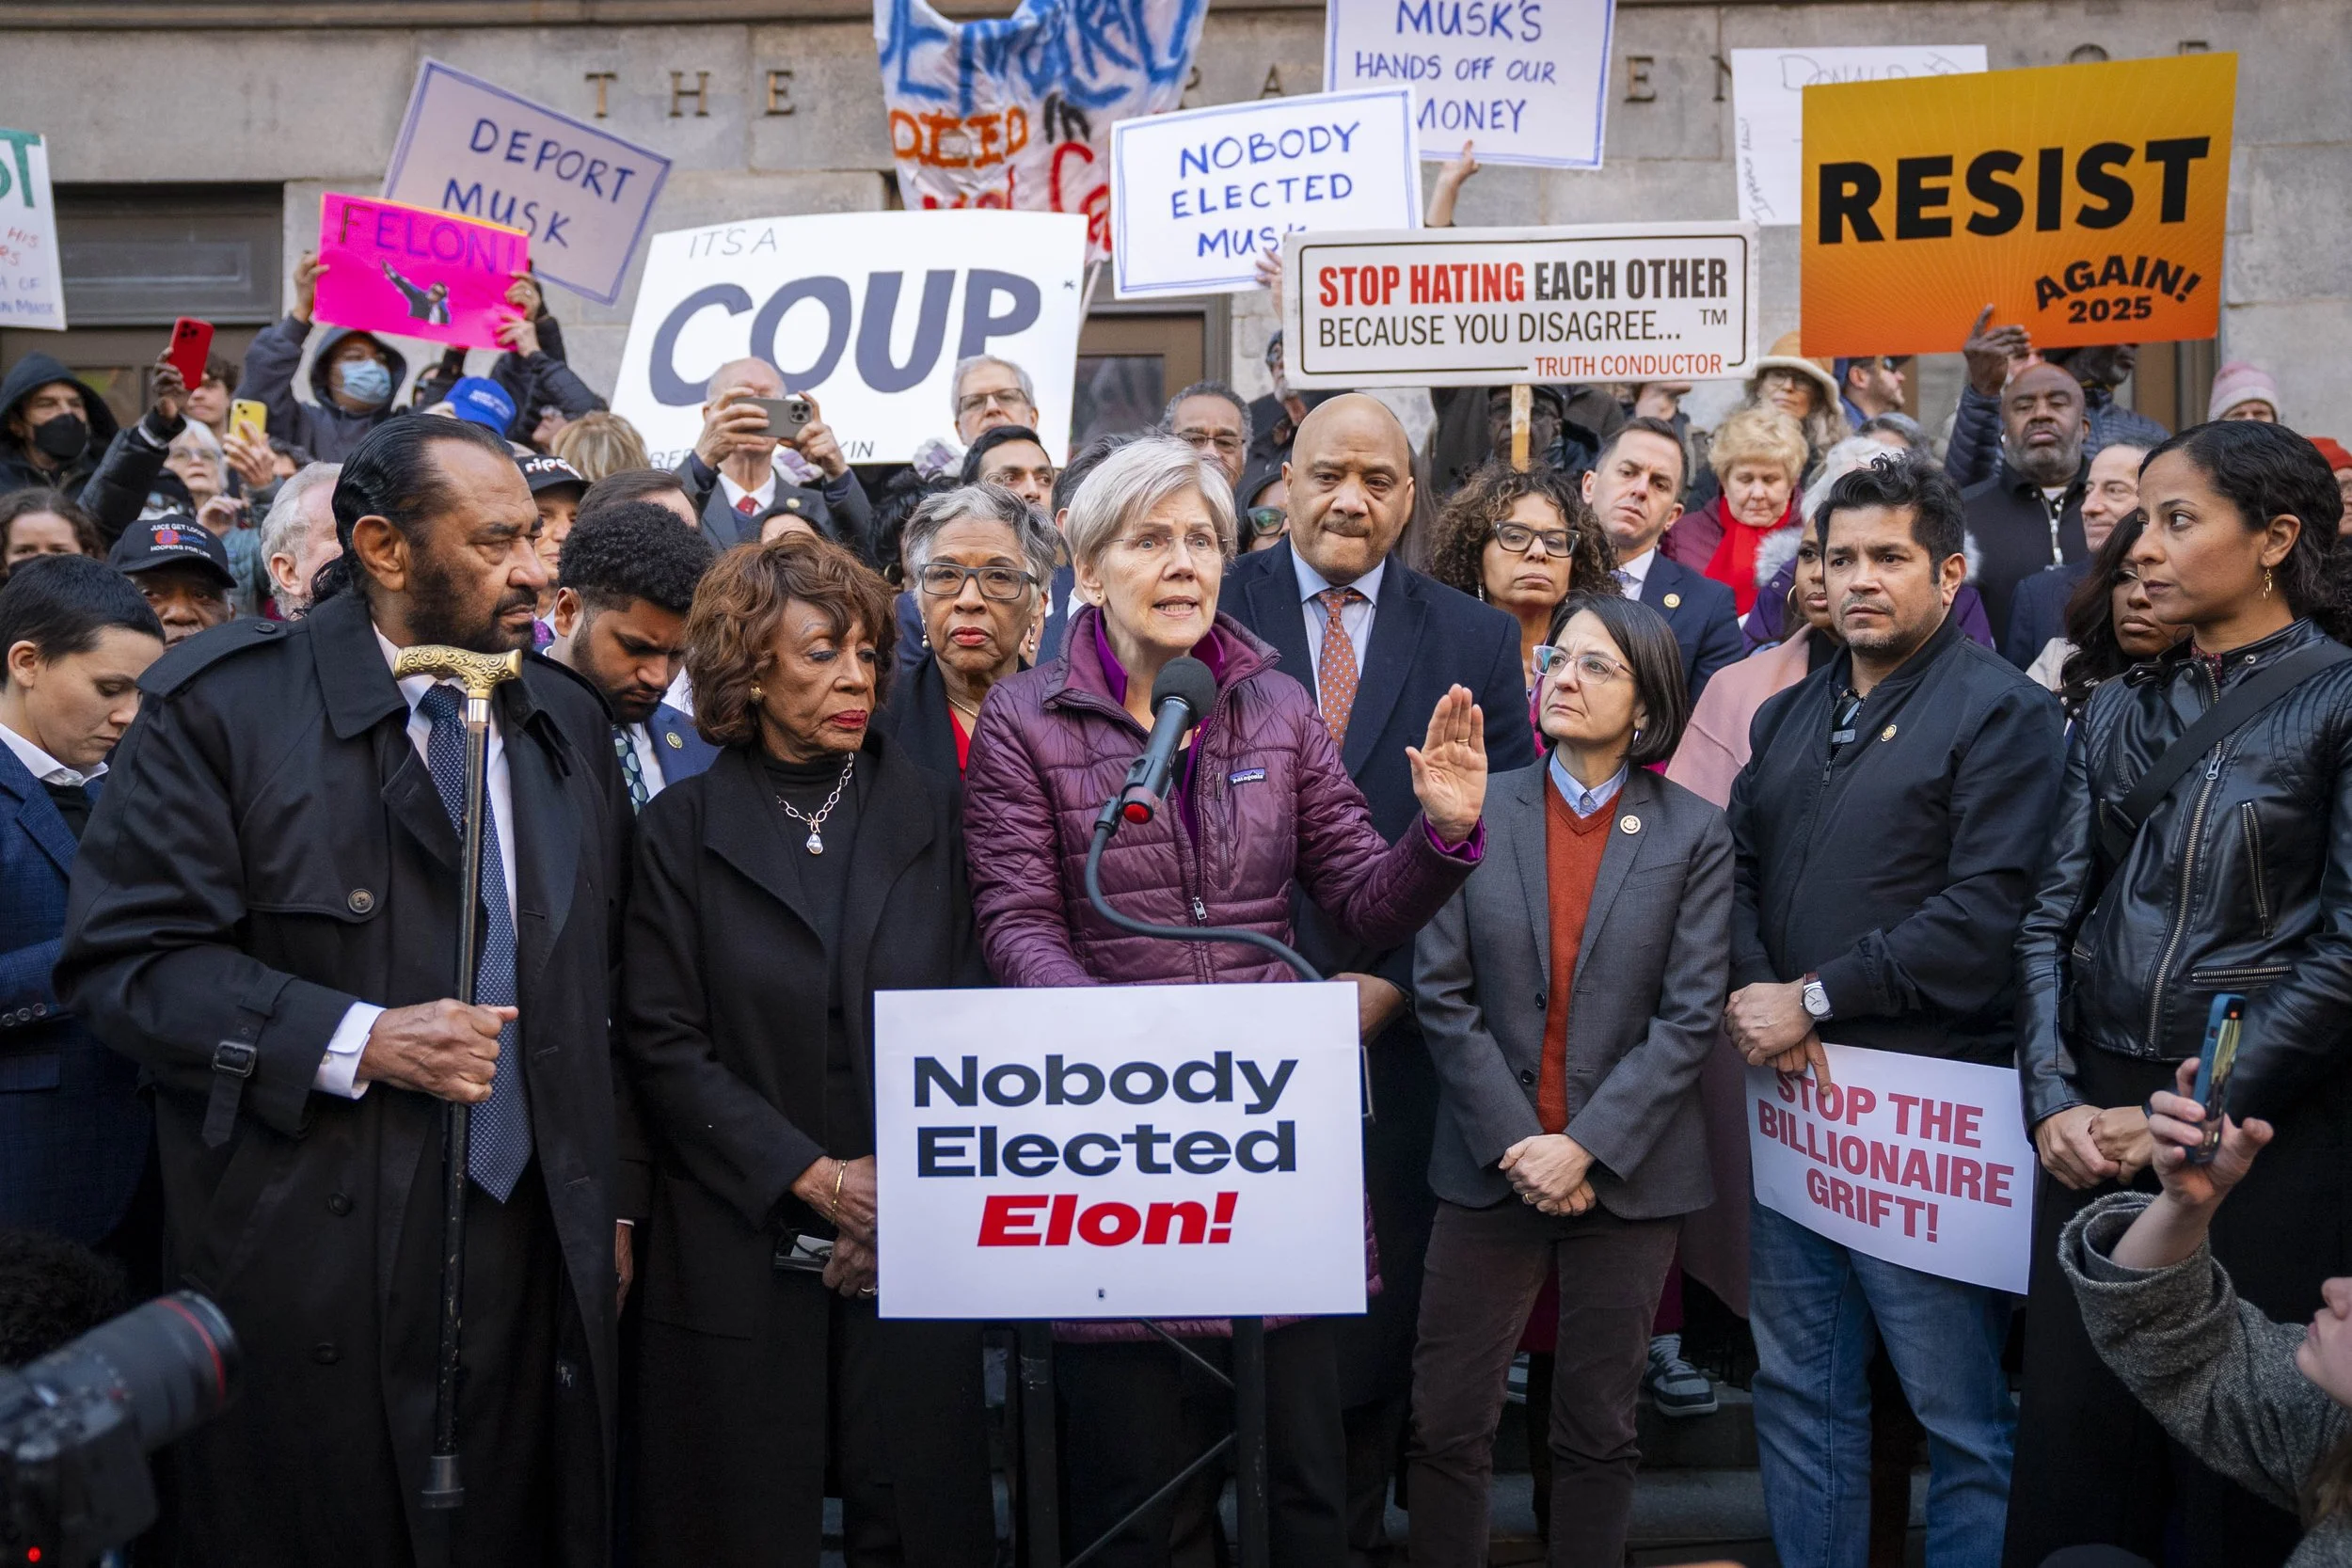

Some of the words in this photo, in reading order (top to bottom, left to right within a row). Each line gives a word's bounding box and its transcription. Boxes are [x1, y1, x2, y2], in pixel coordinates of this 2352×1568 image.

[1356, 51, 1441, 81] HANDS
[1455, 56, 1495, 81] OFF
[1506, 59, 1557, 85] OUR
[469, 118, 635, 203] DEPORT
[1180, 120, 1360, 180] NOBODY
[442, 178, 571, 248] MUSK
[1171, 173, 1353, 219] ELECTED
[1819, 136, 2211, 245] RESIST
[750, 228, 778, 255] A
[1319, 265, 1400, 307] STOP
[1410, 261, 1524, 305] HATING
[1534, 260, 1616, 302] EACH
[1626, 258, 1728, 300] OTHER
[2035, 255, 2201, 312] AGAIN!
[2068, 296, 2153, 324] 2025
[649, 269, 1041, 406] COUP
[1319, 315, 1444, 348] BECAUSE
[1455, 313, 1507, 345] YOU
[1518, 310, 1681, 344] DISAGREE...
[1701, 309, 1727, 325] TM
[1535, 356, 1595, 377] TRUTH
[1600, 354, 1722, 376] CONDUCTOR
[1232, 773, 1263, 784] patagonia
[913, 1051, 1299, 1116] Nobody
[1777, 1072, 1877, 1127] STOP
[1888, 1092, 1983, 1148] THE
[916, 1119, 1296, 1179] Elected
[1757, 1098, 2014, 1208] BILLIONAIRE
[977, 1191, 1239, 1248] Elon!
[1806, 1167, 1939, 1243] GRIFT!
